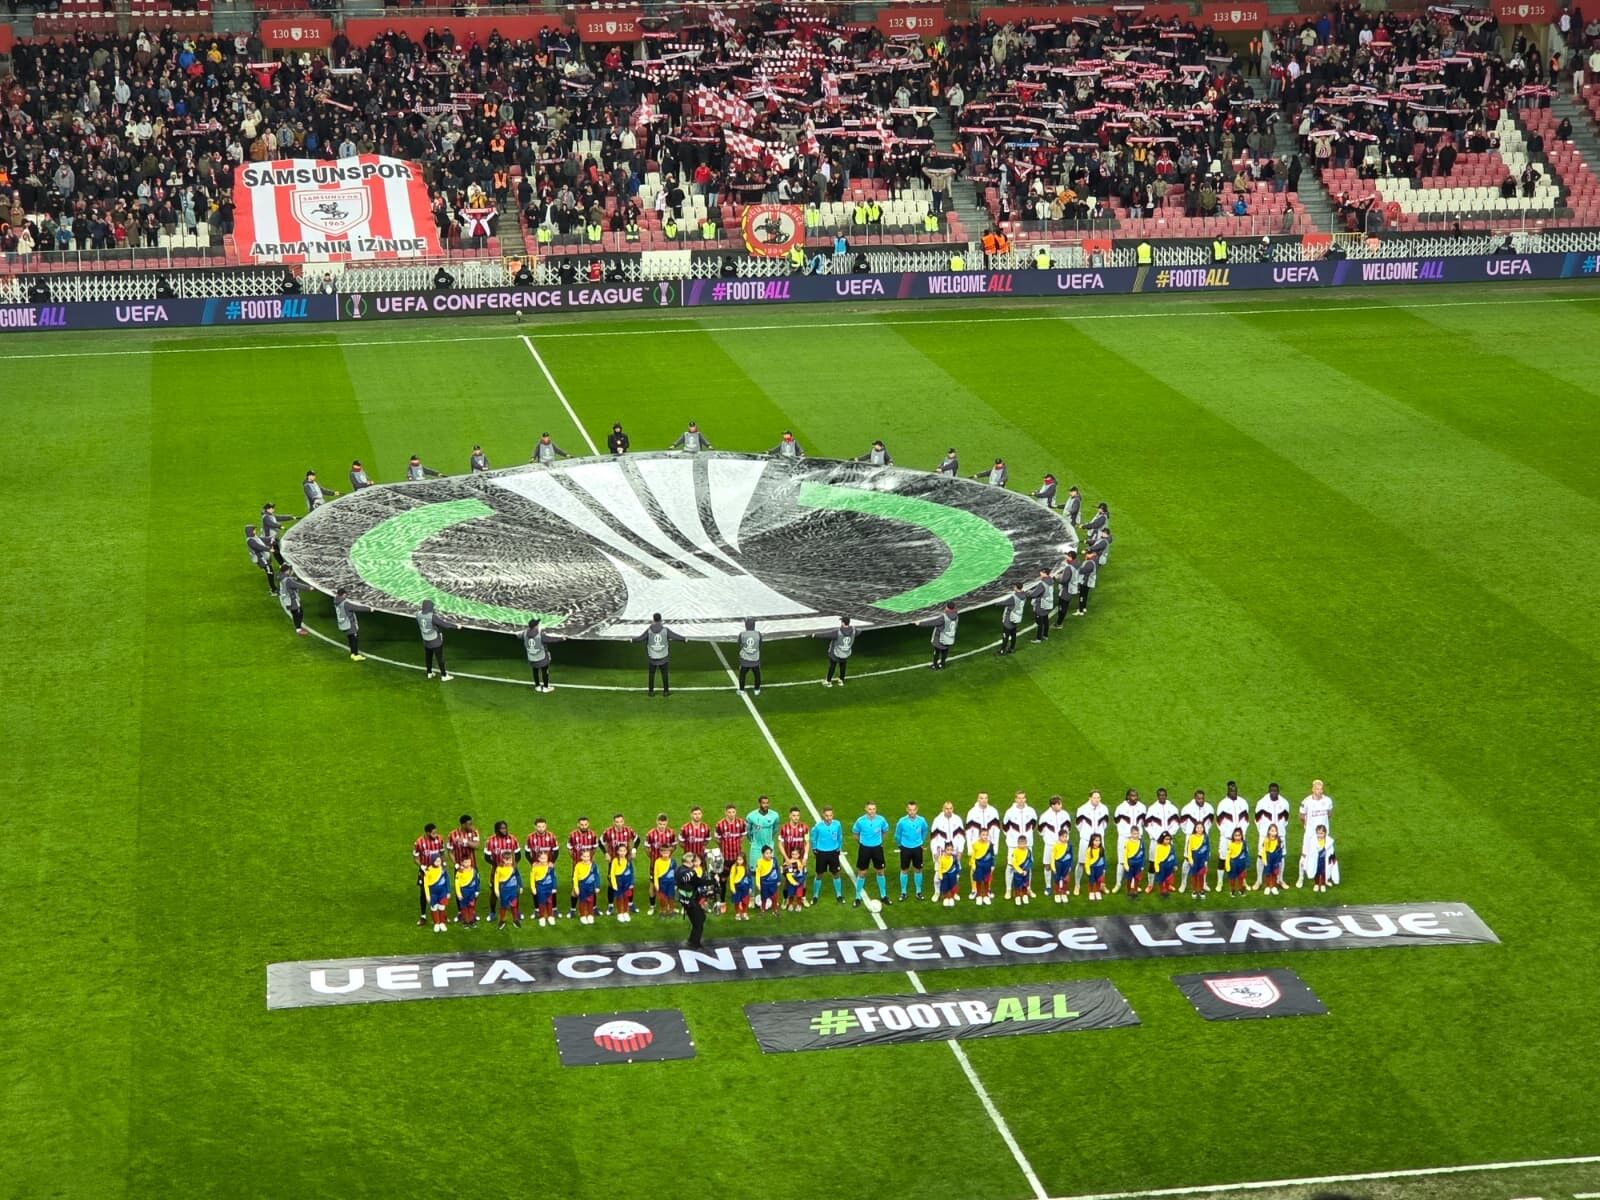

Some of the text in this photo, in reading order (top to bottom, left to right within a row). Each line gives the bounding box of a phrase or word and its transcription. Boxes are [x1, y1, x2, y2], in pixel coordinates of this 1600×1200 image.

[1214, 11, 1257, 22] 133 134
[1501, 6, 1545, 16] 134 135
[588, 23, 634, 33] 131 132
[889, 18, 934, 28] 132 133
[272, 29, 320, 39] 130 131
[244, 163, 411, 188] SAMSUNSPOR
[1272, 267, 1320, 283] UEFA
[1362, 261, 1445, 281] WELCOME ALL
[1486, 260, 1532, 276] UEFA
[928, 274, 1014, 294] WELCOME ALL
[1057, 274, 1104, 290] UEFA
[1155, 268, 1230, 288] #FOOTBALL
[711, 281, 791, 301] #FOOTBALL
[836, 279, 884, 296] UEFA
[225, 299, 309, 320] #FOOTBALL
[376, 296, 429, 313] UEFA
[433, 290, 562, 311] CONFERENCE
[38, 307, 67, 326] ALL
[116, 305, 169, 322] UEFA
[309, 961, 536, 994] UEFA
[556, 926, 1108, 979] CONFERENCE
[811, 994, 1080, 1035] #FOOTBALL
